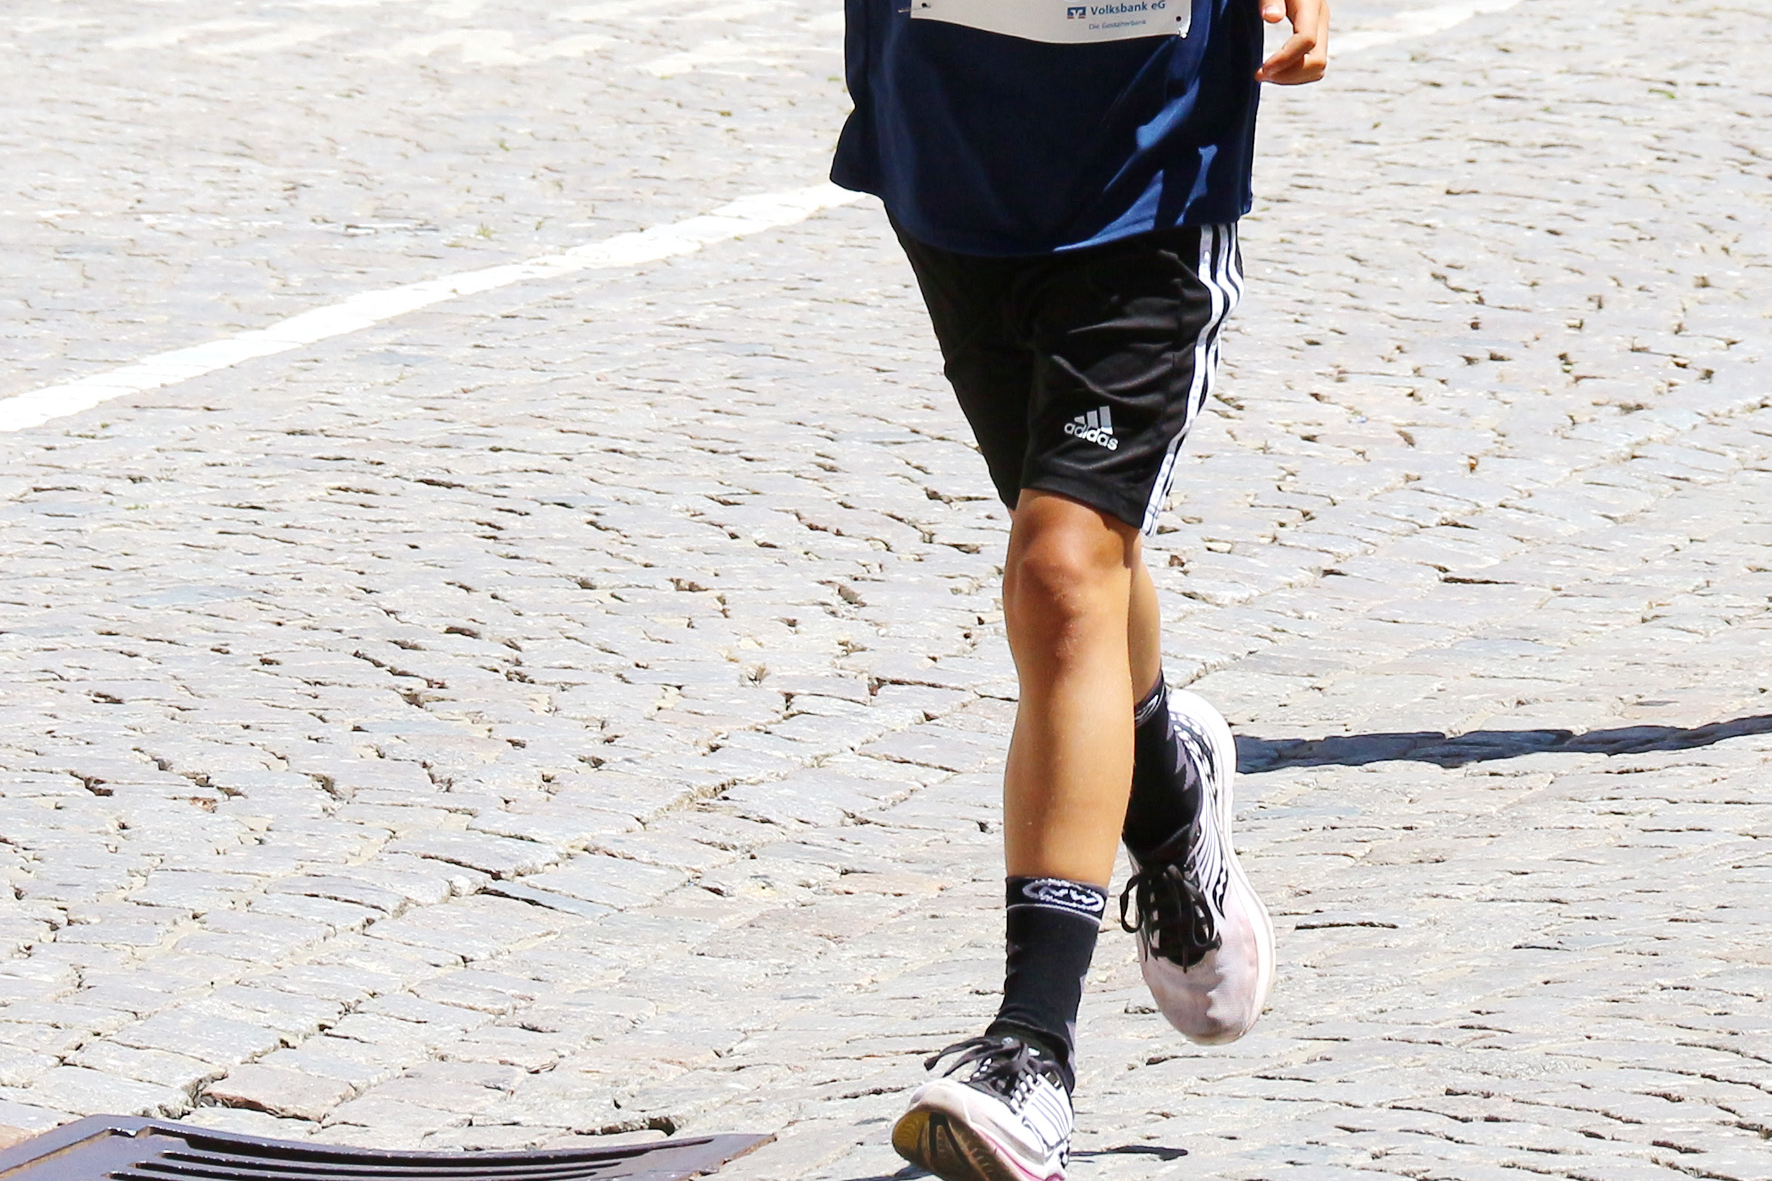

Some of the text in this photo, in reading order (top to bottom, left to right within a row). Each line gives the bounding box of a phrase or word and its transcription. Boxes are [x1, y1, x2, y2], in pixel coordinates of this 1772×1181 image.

[1090, 0, 1166, 16] Volksbank eG
[1064, 421, 1119, 451] adidas
